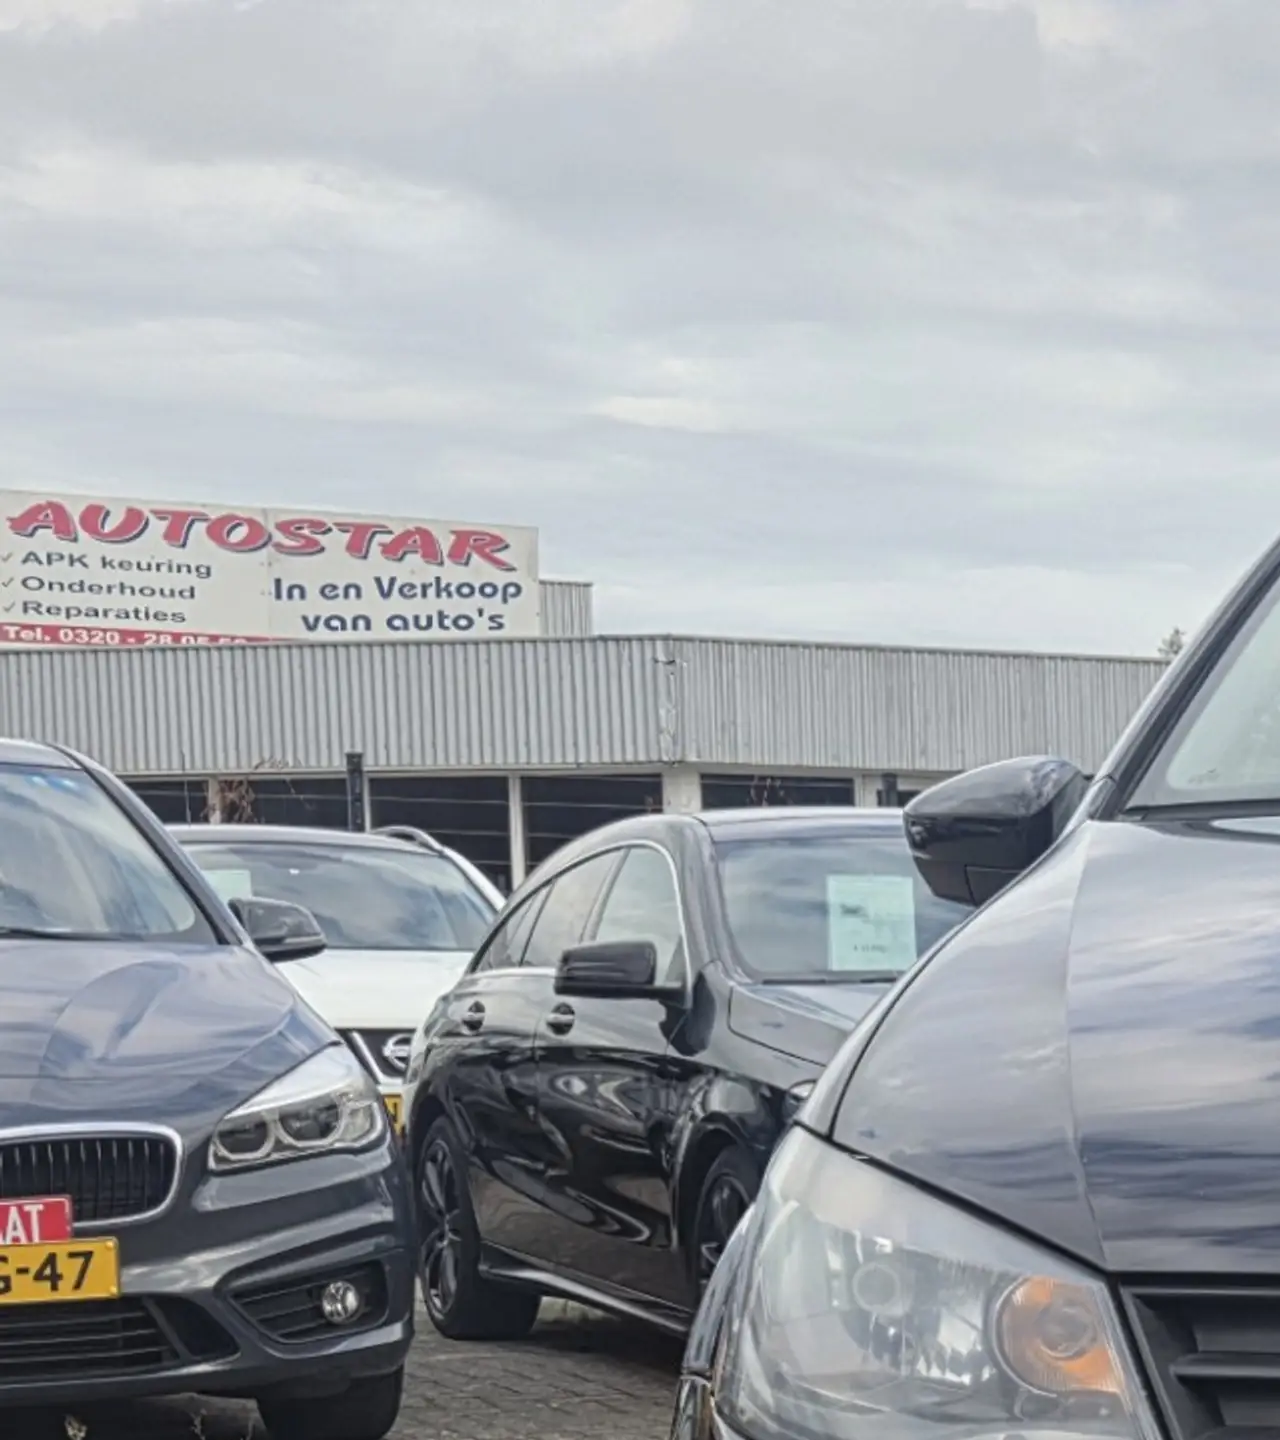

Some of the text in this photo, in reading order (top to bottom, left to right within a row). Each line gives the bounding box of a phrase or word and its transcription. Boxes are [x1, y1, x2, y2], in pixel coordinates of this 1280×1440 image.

[6, 500, 517, 571] AUTOSTAR
[21, 551, 212, 579] APK keuring
[21, 576, 196, 599] Onderhoud
[274, 576, 522, 603] In en Verkoop
[22, 601, 187, 623] Reparaties
[301, 608, 505, 631] van auto's
[3, 626, 51, 642] Tel.
[59, 629, 120, 644] 0320
[0, 1204, 44, 1244] AT
